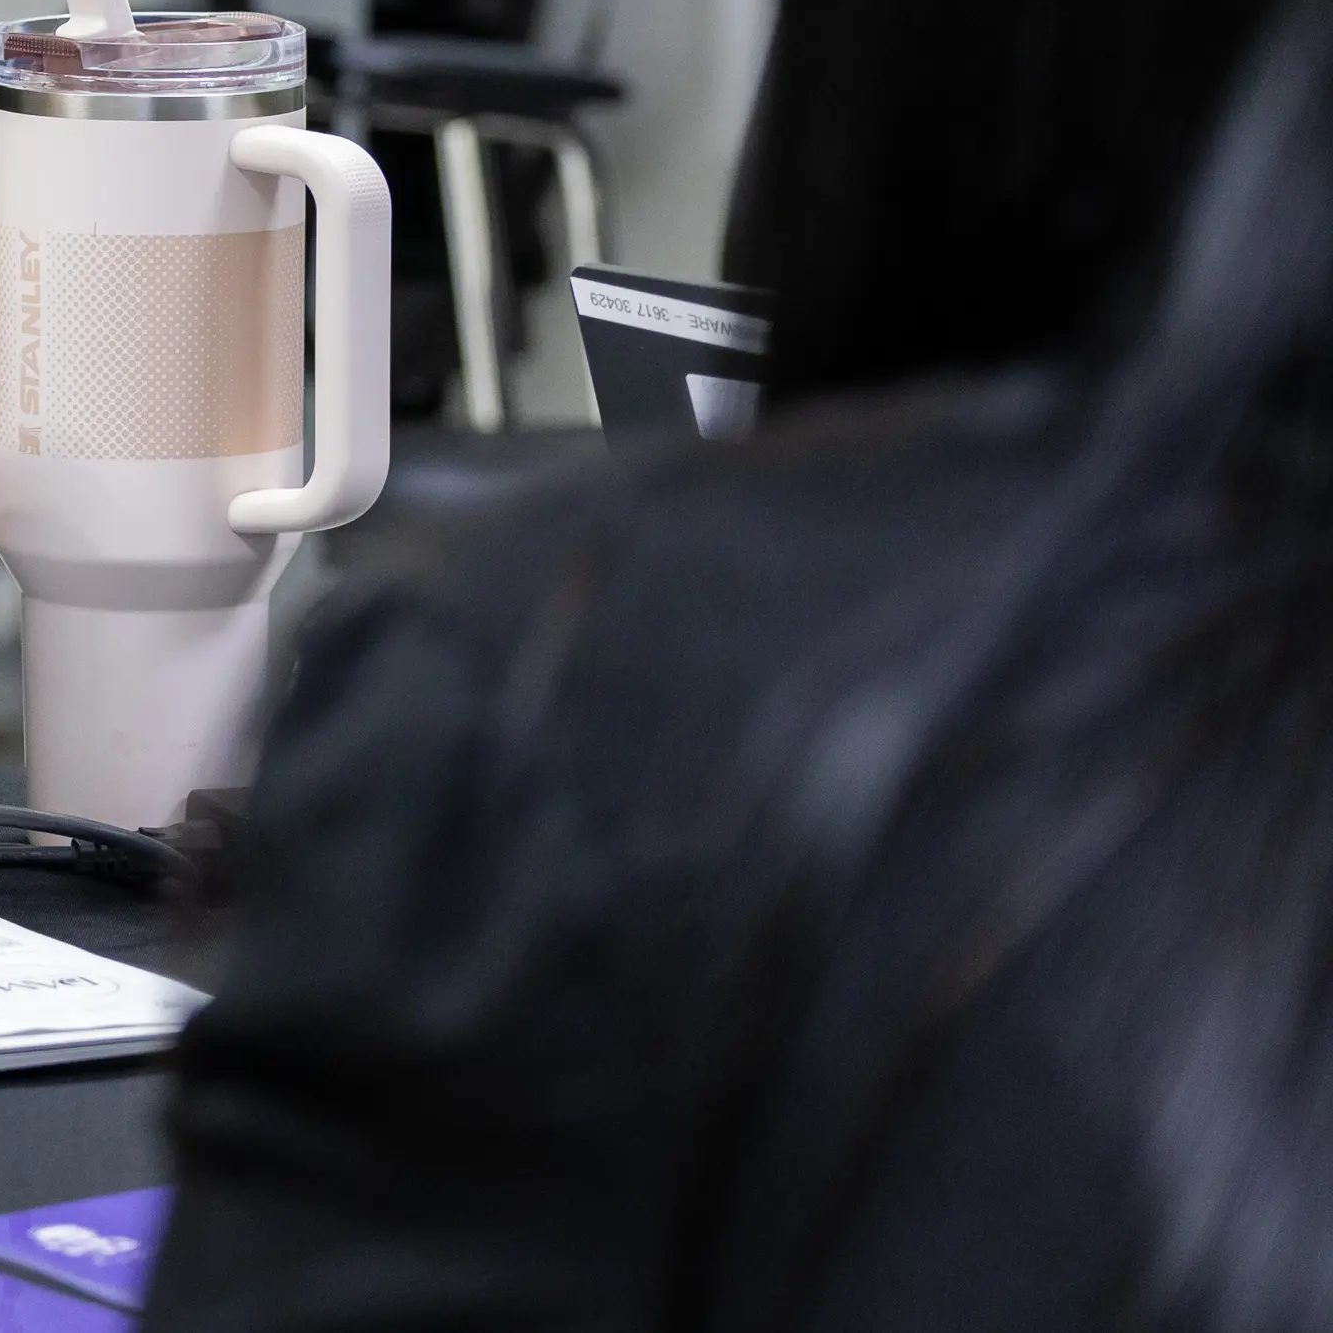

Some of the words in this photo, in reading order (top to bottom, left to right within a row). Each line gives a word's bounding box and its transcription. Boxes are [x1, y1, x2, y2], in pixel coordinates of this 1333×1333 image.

[590, 292, 632, 313] 30429
[637, 302, 671, 322] 3617
[19, 230, 41, 415] STANLEY
